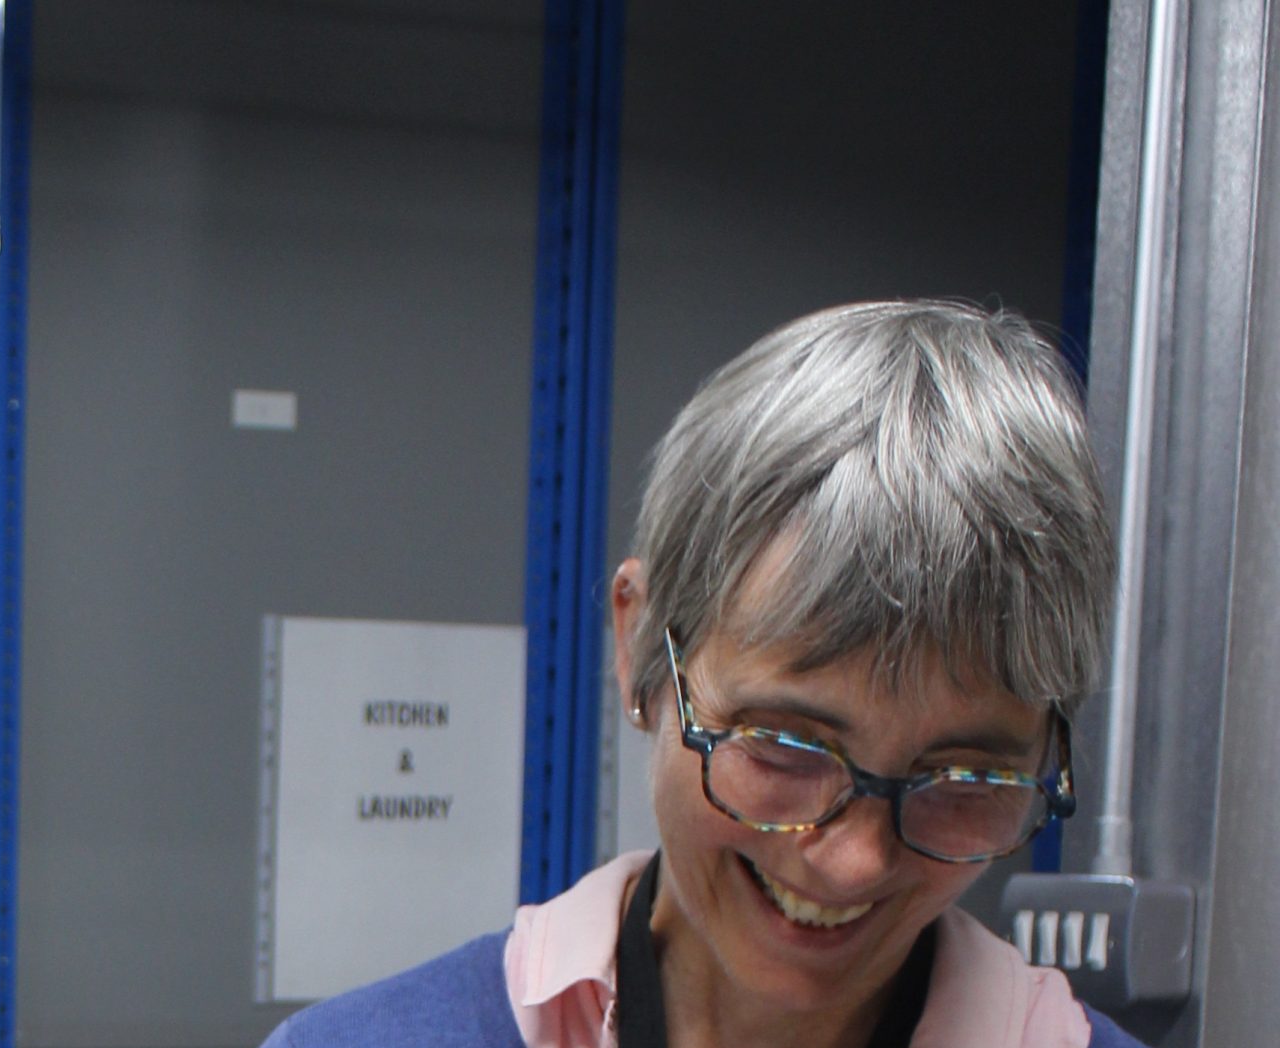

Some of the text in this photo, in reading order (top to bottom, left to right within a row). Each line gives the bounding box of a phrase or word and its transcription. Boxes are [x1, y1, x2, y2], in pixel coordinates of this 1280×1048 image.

[364, 701, 449, 726] KITCHEN
[398, 750, 415, 773] &
[358, 796, 454, 820] LAUNDRY
